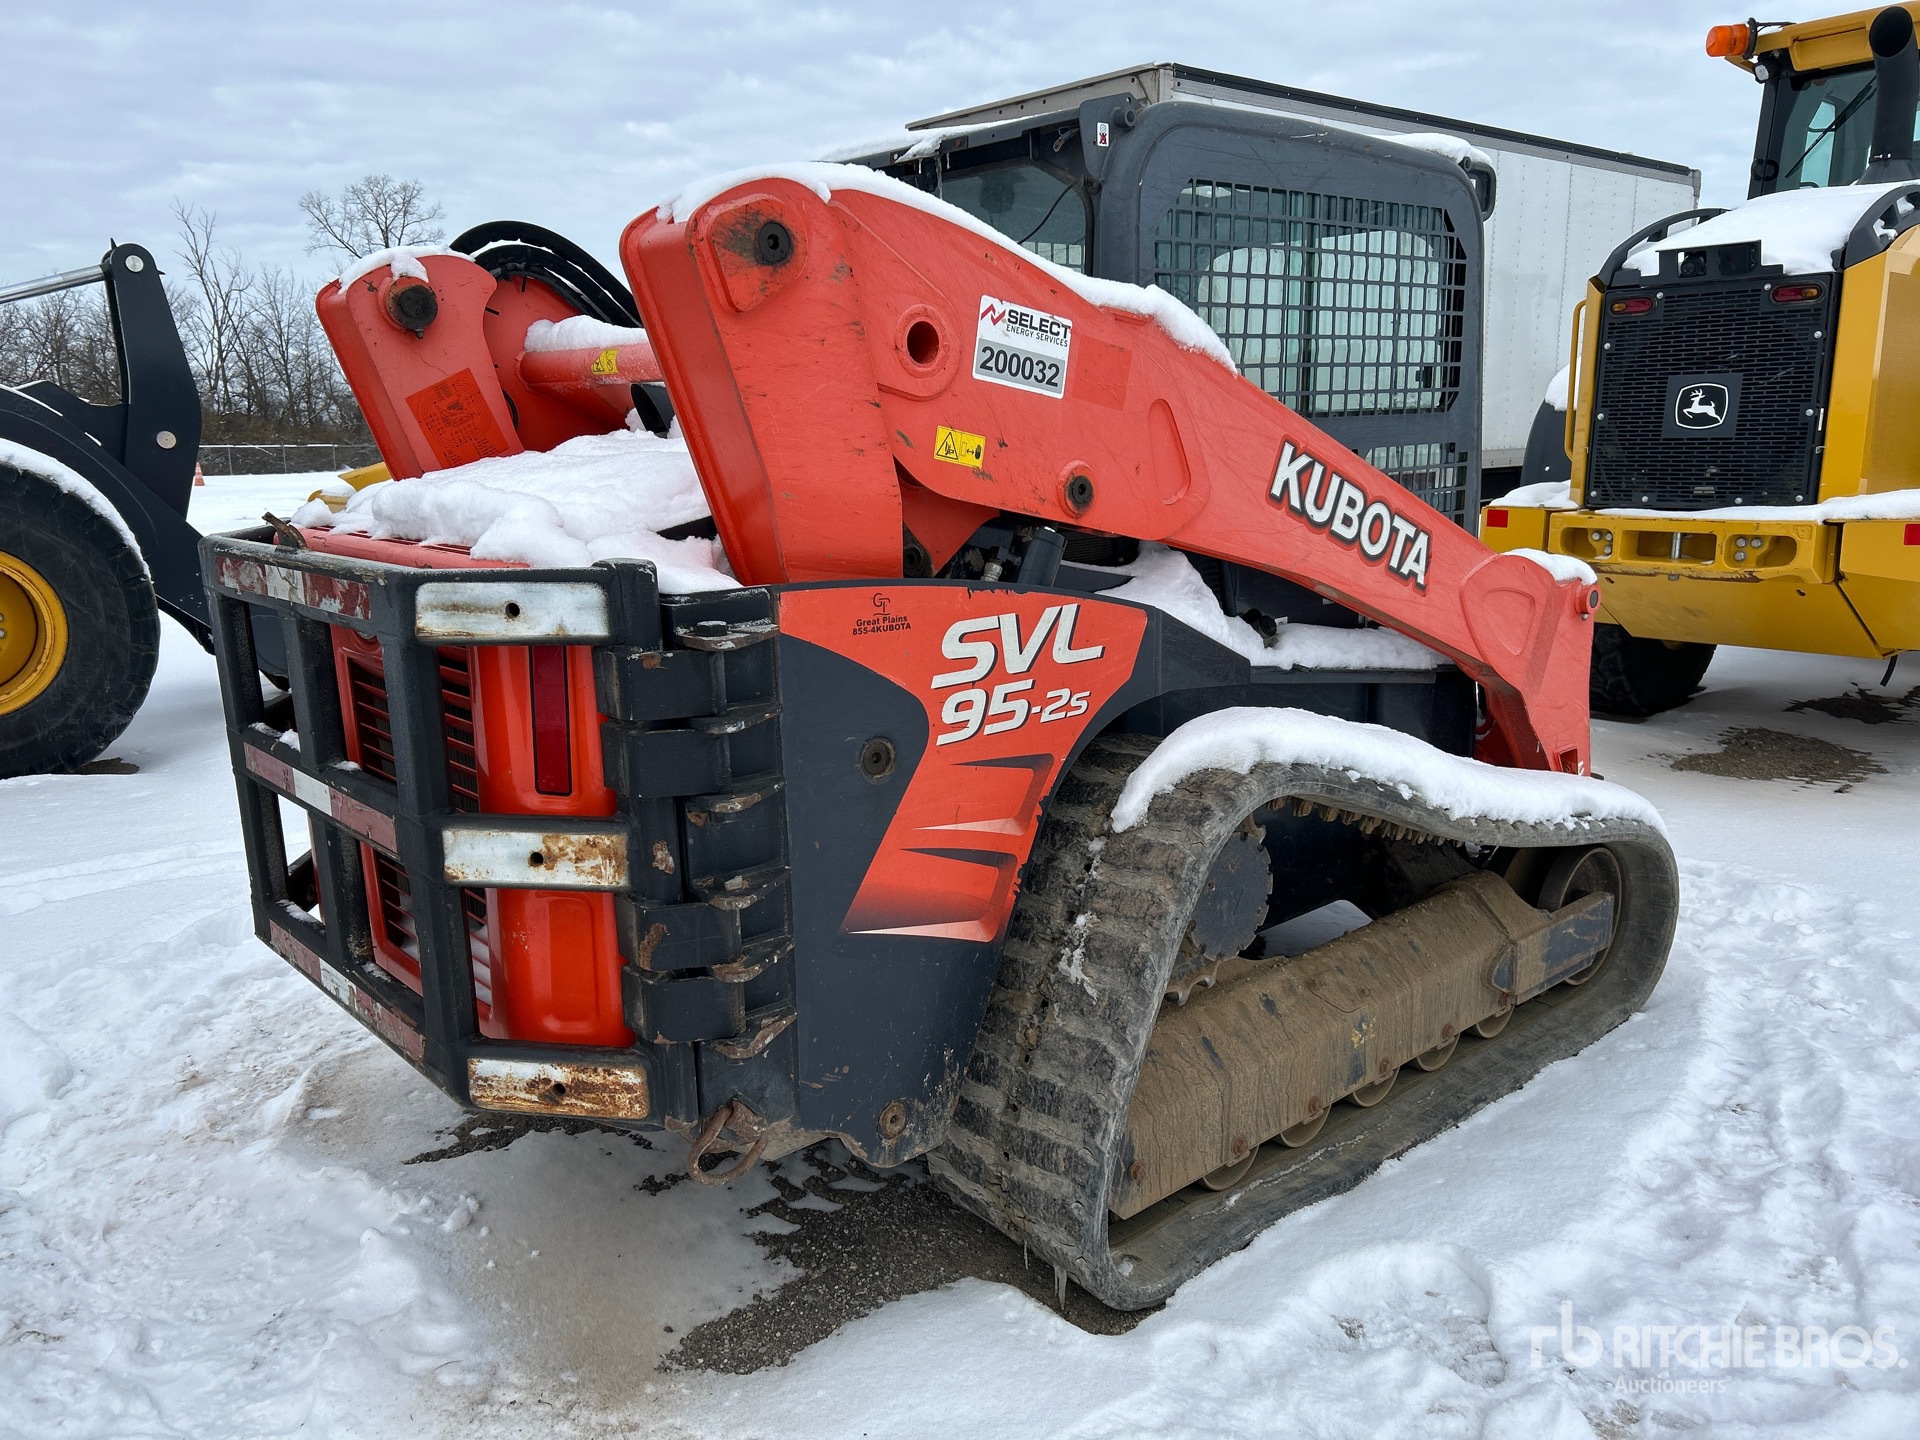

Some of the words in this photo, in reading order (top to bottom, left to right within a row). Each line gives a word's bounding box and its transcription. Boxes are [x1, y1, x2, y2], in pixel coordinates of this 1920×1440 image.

[1006, 324, 1034, 338] ENERGY
[1035, 332, 1068, 348] SERVICES
[1007, 309, 1071, 339] SELECT
[979, 346, 1060, 387] 200032
[1270, 441, 1429, 586] KUBOTA
[852, 622, 911, 636] 855-4KUBOTA
[856, 617, 880, 627] Great
[882, 615, 908, 624] Plains
[931, 603, 1103, 689] SVL
